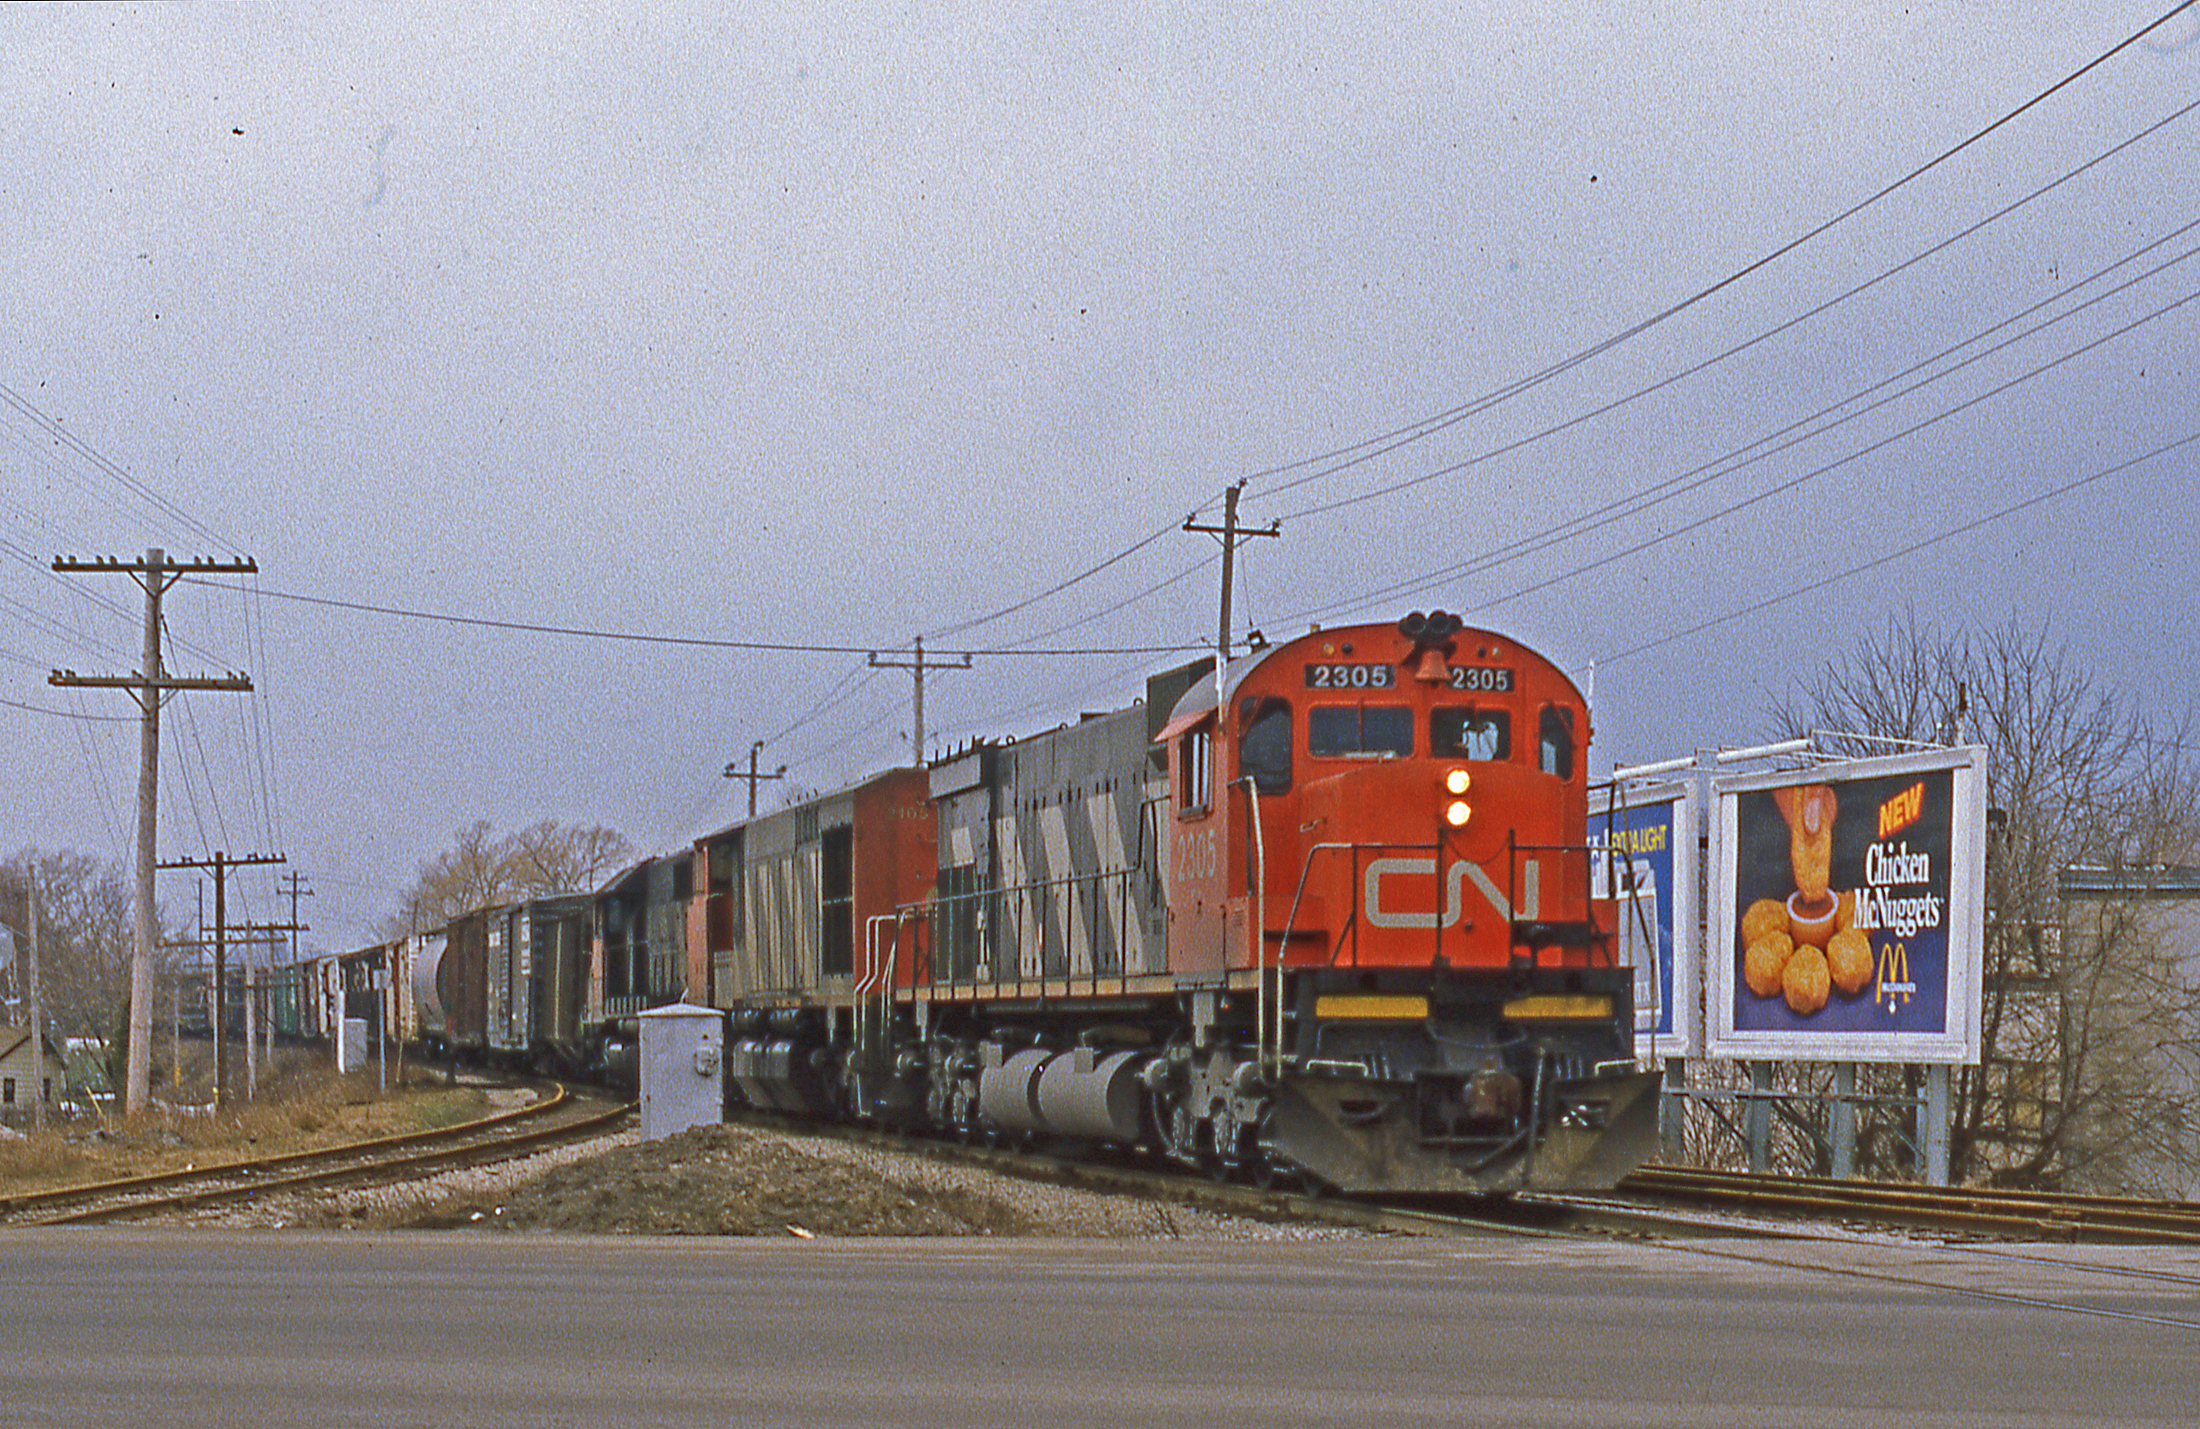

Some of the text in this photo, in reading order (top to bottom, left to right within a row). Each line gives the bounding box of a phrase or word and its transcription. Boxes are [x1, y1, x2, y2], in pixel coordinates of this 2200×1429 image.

[1314, 664, 1388, 688] 2305
[1452, 667, 1508, 691] 2305
[1879, 781, 1924, 839] NEW
[1177, 828, 1216, 882] 2305
[1640, 824, 1667, 853] LIGHT
[1866, 841, 1930, 887] Chicken
[1364, 857, 1540, 929] CN
[1852, 886, 1940, 938] McNuggets
